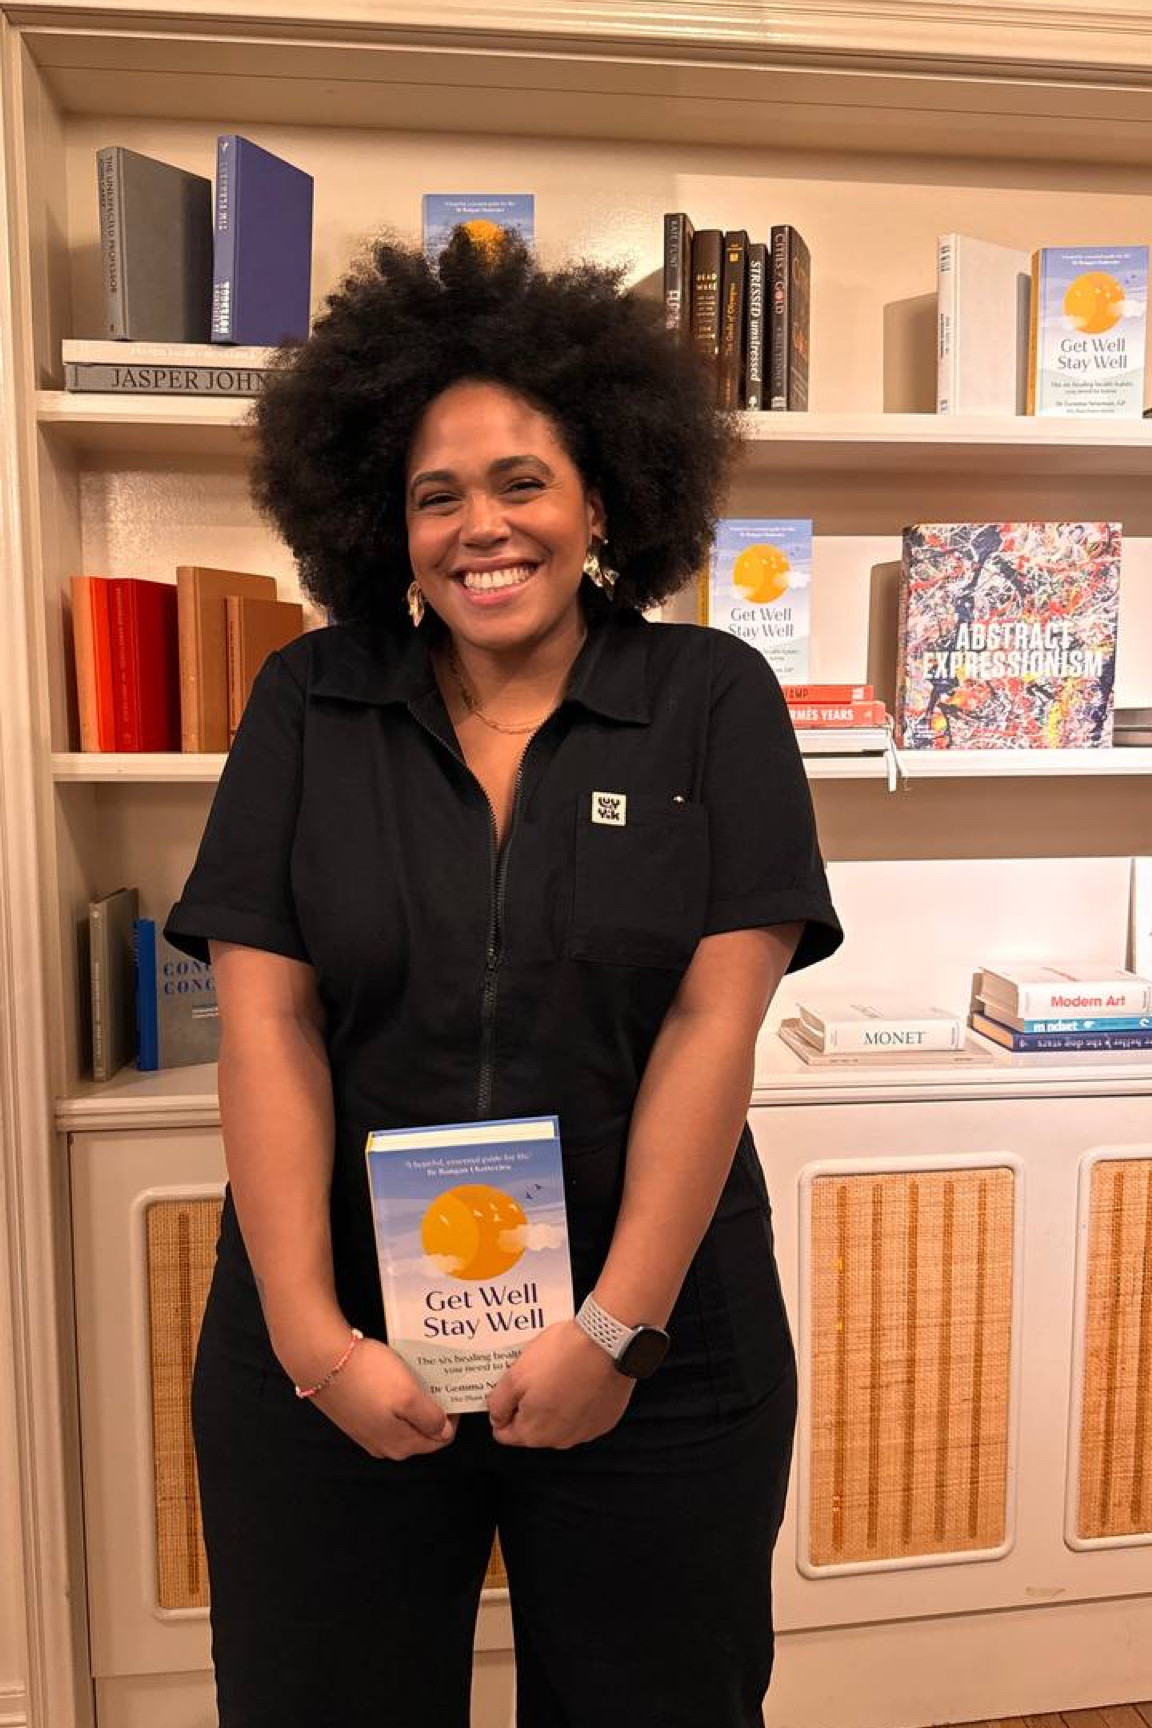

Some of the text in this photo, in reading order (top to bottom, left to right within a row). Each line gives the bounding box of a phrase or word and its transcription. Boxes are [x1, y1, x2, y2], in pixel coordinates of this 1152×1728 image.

[106, 176, 116, 237] UNEXPECTED
[108, 240, 118, 294] PROFESSOR
[750, 260, 761, 382] STRESSED unstressed
[1060, 338, 1126, 353] Get Well
[1057, 355, 1128, 373] Stay Well
[111, 368, 198, 389] JASPER
[730, 607, 792, 622] Get Well
[727, 623, 795, 640] Stay Well
[957, 622, 1072, 651] ABSTRACT
[922, 650, 1103, 680] EXPRESSIONISM
[820, 708, 854, 721] YEARS
[1051, 994, 1126, 1008] Modern Art
[864, 1031, 925, 1046] MONET
[425, 1283, 538, 1311] Get Well
[423, 1308, 545, 1339] Stay Well
[416, 1356, 436, 1365] The
[438, 1356, 453, 1365] six
[454, 1353, 492, 1364] healing
[444, 1367, 463, 1375] you
[465, 1363, 490, 1372] need
[444, 1384, 484, 1393] Gemma
